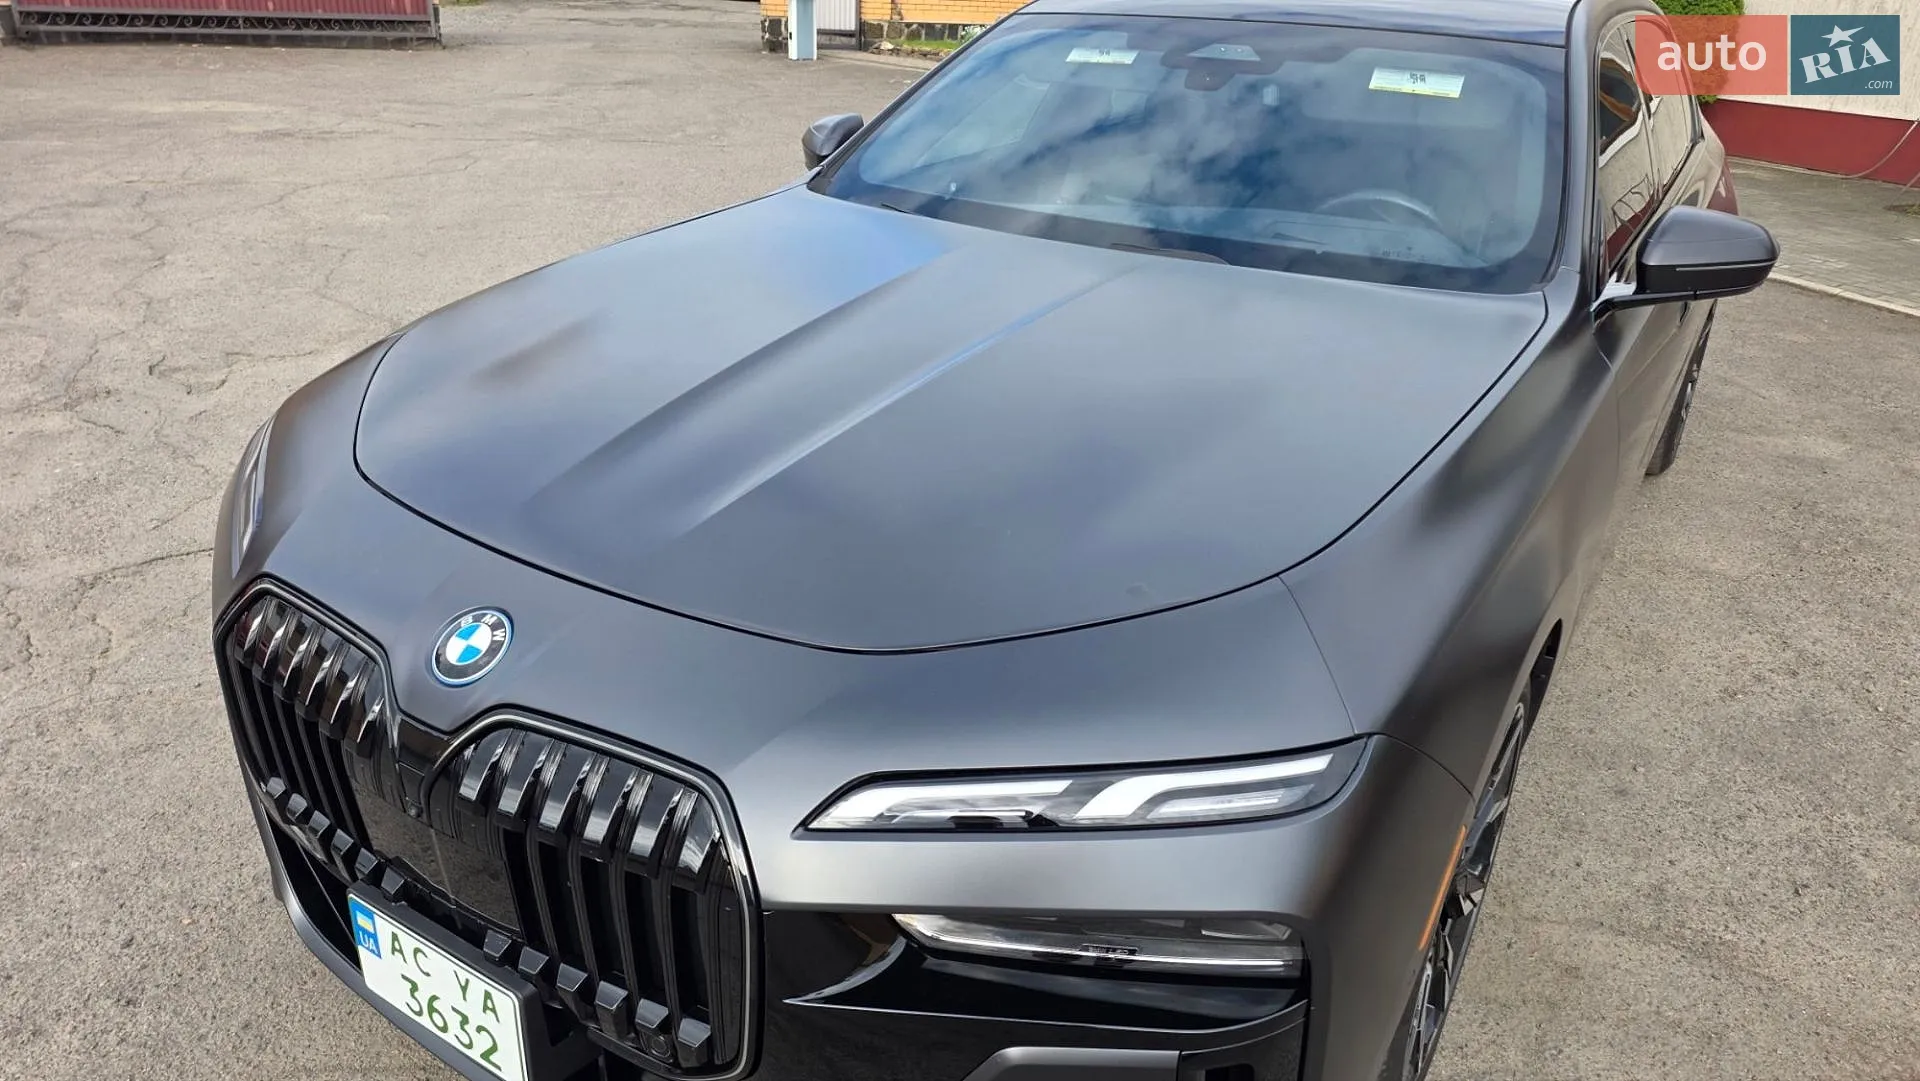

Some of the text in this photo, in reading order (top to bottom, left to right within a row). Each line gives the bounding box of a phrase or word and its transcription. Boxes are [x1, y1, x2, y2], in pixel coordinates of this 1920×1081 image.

[461, 613, 506, 641] BMW
[359, 930, 378, 951] UA
[391, 931, 501, 1024] AC YA
[401, 973, 503, 1072] 3632
